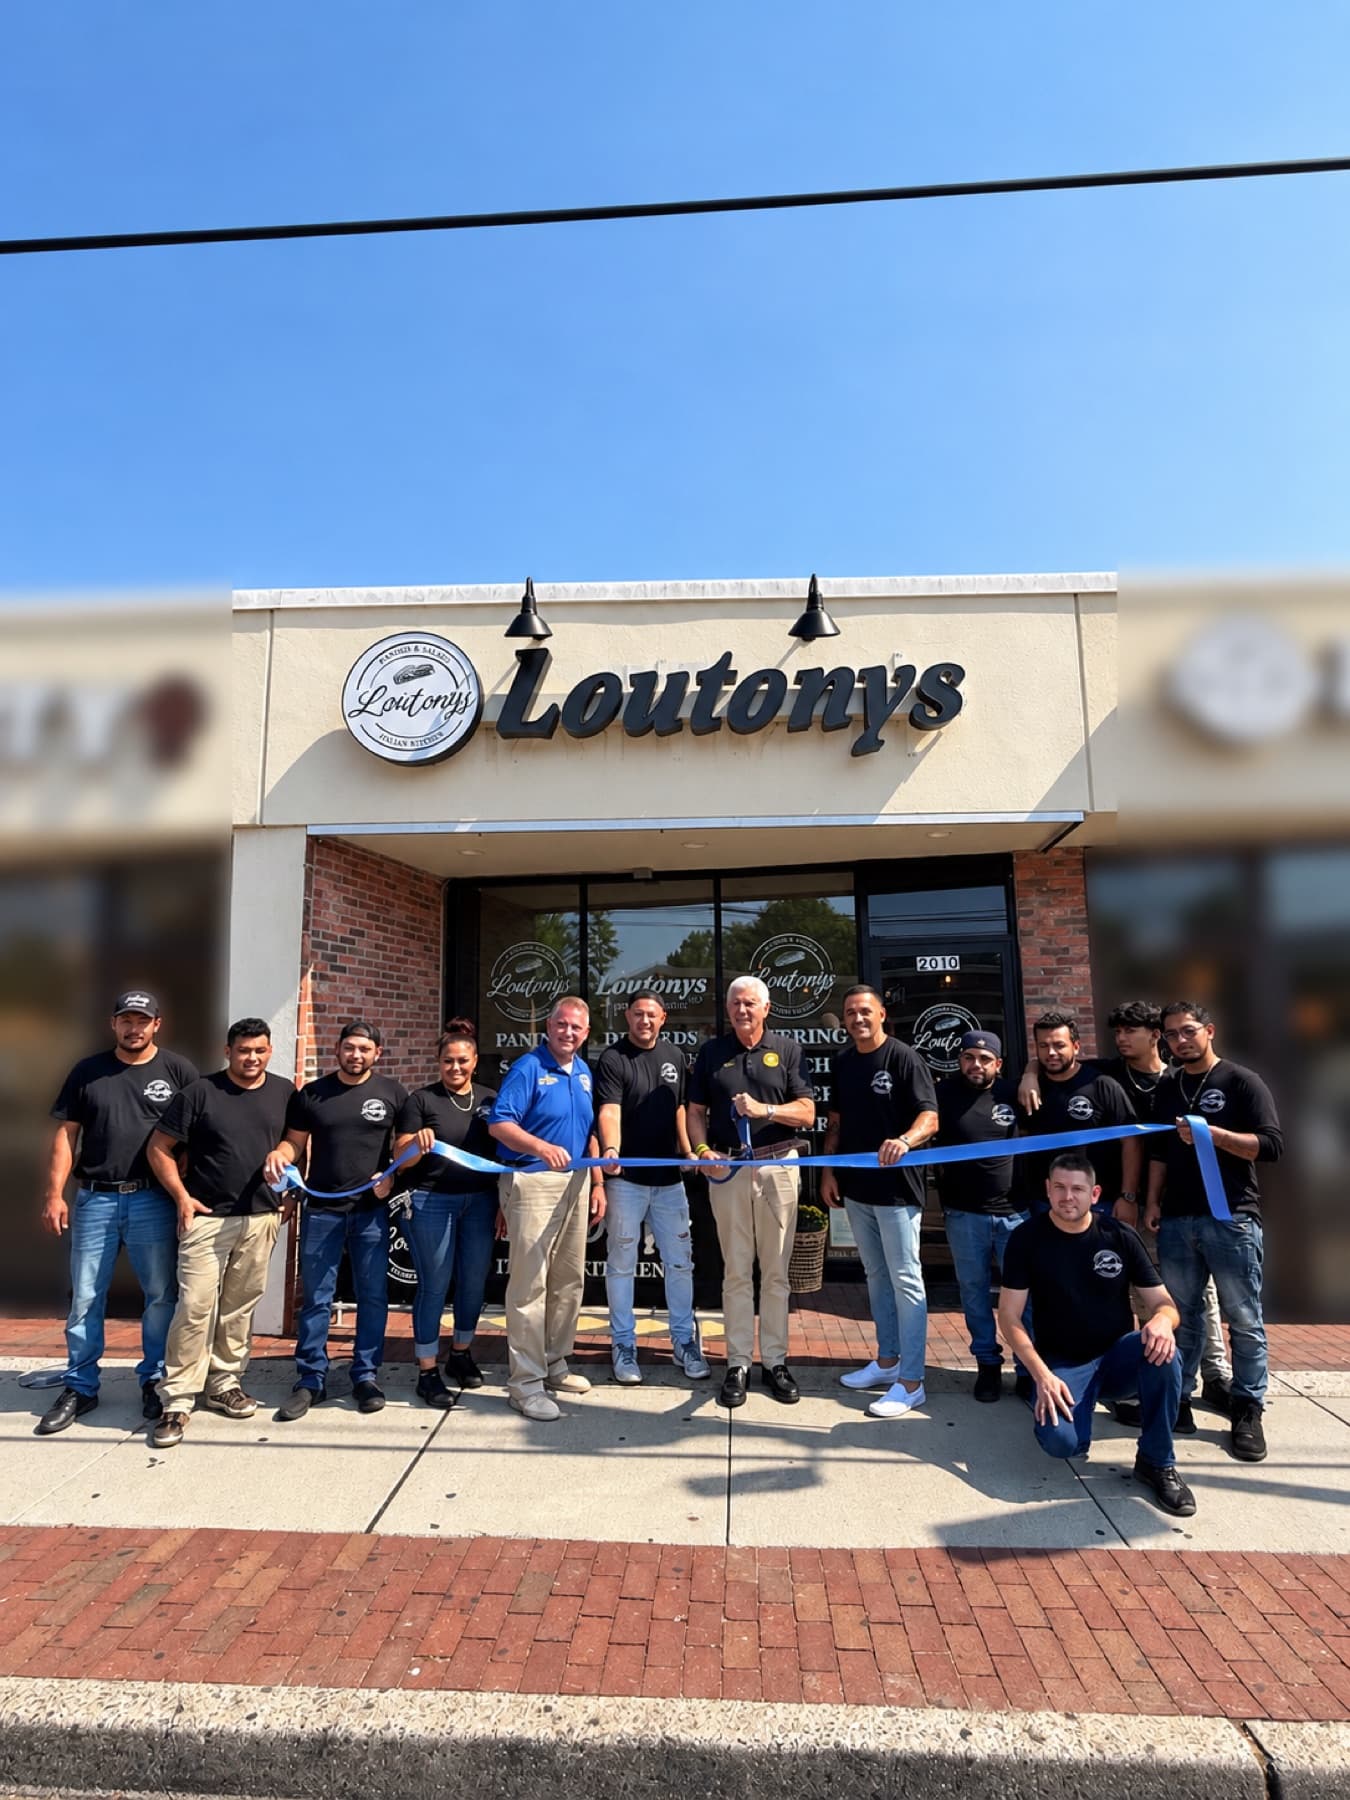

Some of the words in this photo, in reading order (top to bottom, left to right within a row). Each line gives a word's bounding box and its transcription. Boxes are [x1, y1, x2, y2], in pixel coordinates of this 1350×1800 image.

[347, 685, 477, 721] Loutonys
[497, 648, 966, 758] Loutonys
[919, 956, 958, 970] 2010
[486, 973, 570, 1001] Loutonys
[595, 975, 707, 1000] Loutonys
[911, 1031, 962, 1052] Louto
